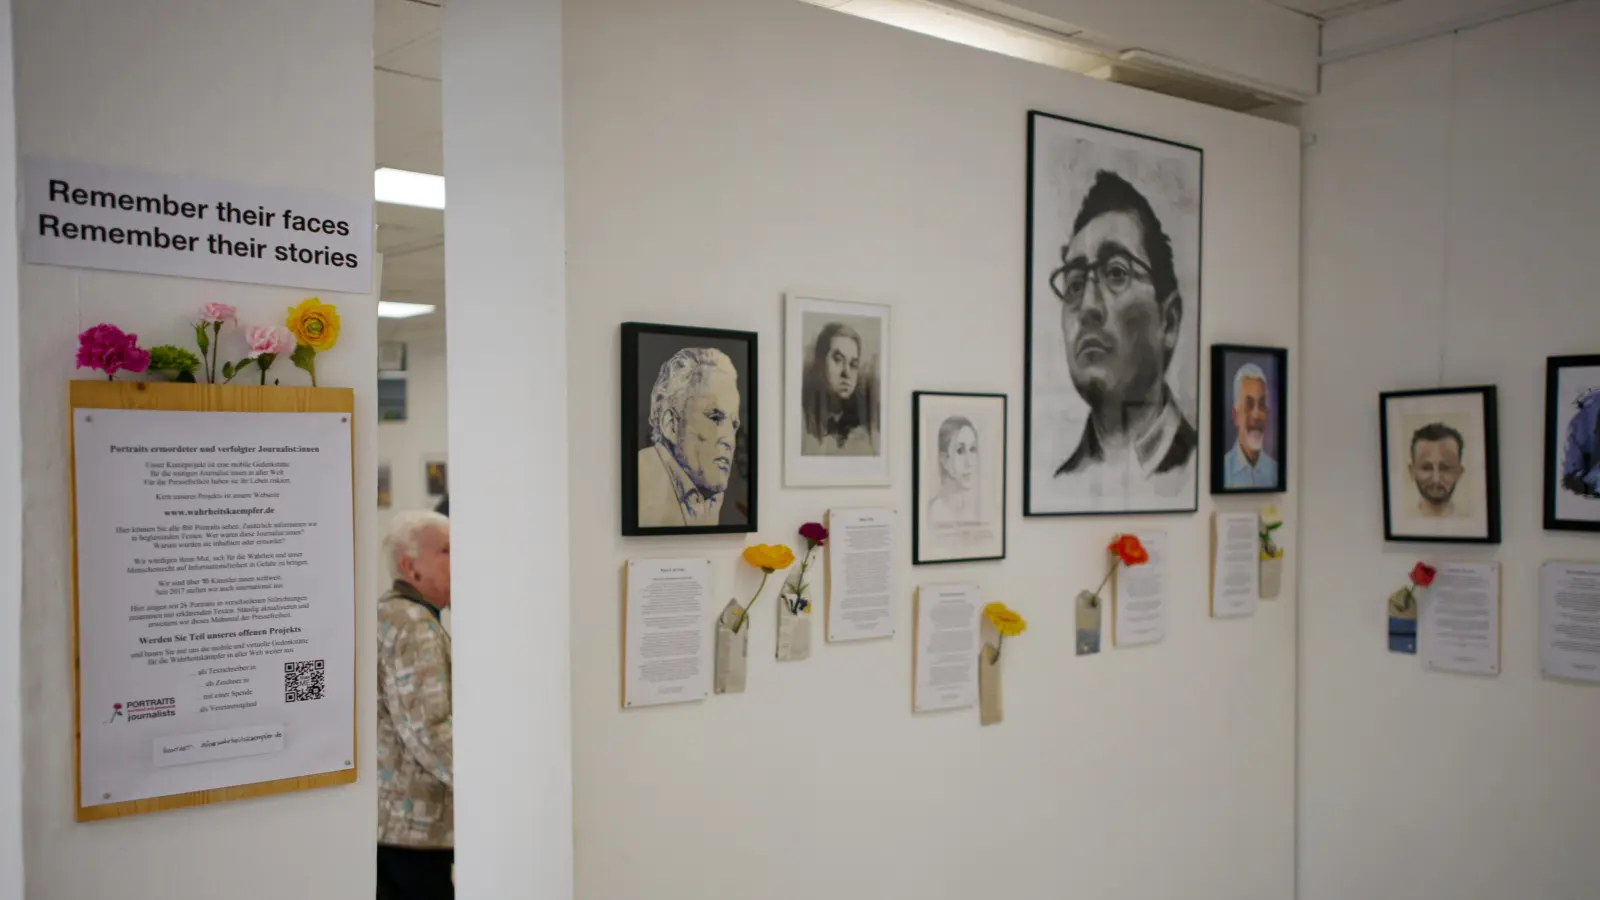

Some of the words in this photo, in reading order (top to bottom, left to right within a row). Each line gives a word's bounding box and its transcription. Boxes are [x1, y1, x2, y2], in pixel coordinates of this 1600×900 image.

[48, 179, 208, 220] Remember
[216, 202, 276, 227] their
[282, 209, 350, 236] faces
[38, 213, 199, 252] Remember
[207, 233, 267, 259] their
[274, 244, 359, 269] stories
[109, 445, 148, 453] Portraits
[150, 445, 197, 453] ermordeter
[199, 445, 216, 453] und
[217, 445, 256, 455] verfolgter
[164, 507, 275, 516] www.wahrheitskaempfer.de
[138, 634, 172, 645] Werden
[174, 633, 187, 642] Sie
[189, 632, 205, 641] Teil
[206, 631, 236, 640] unseres
[238, 628, 267, 638] offenen
[268, 625, 301, 638] Projekts
[127, 697, 176, 709] PORTRAITS
[127, 709, 176, 722] journalists
